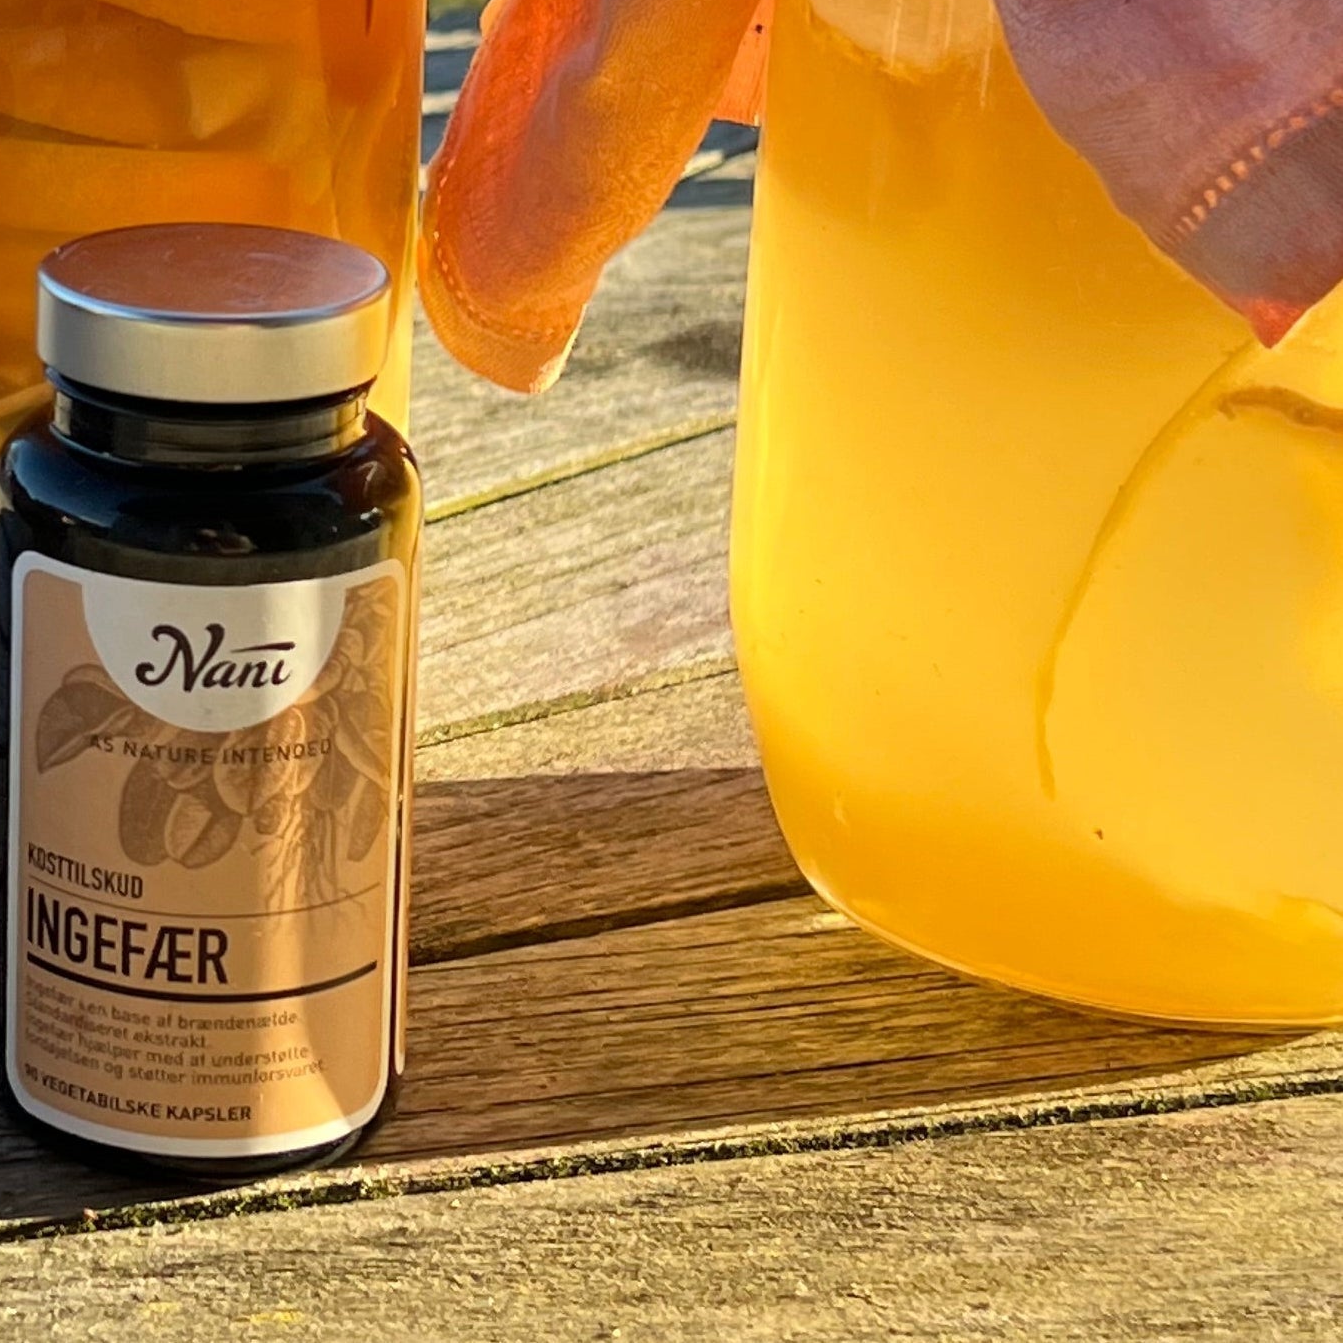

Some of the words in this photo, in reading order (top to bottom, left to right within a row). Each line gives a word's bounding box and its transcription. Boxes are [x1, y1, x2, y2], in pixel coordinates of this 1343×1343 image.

[135, 623, 296, 693] Nani
[89, 734, 114, 753] AS
[123, 740, 215, 765] NATURE
[222, 738, 332, 765] INTENDED
[28, 842, 143, 899] KOSTTILSKUD
[27, 886, 228, 984] INGEFÆR
[111, 1006, 150, 1025] base
[157, 1014, 172, 1028] af
[78, 1032, 142, 1061] hjælper
[146, 1051, 184, 1067] med
[190, 1053, 205, 1067] at
[211, 1046, 309, 1067] understøtte
[104, 1063, 123, 1079] og
[128, 1067, 186, 1083] støtter
[41, 1073, 161, 1118] VEGETABILSKE
[167, 1105, 251, 1122] KAPSLER
